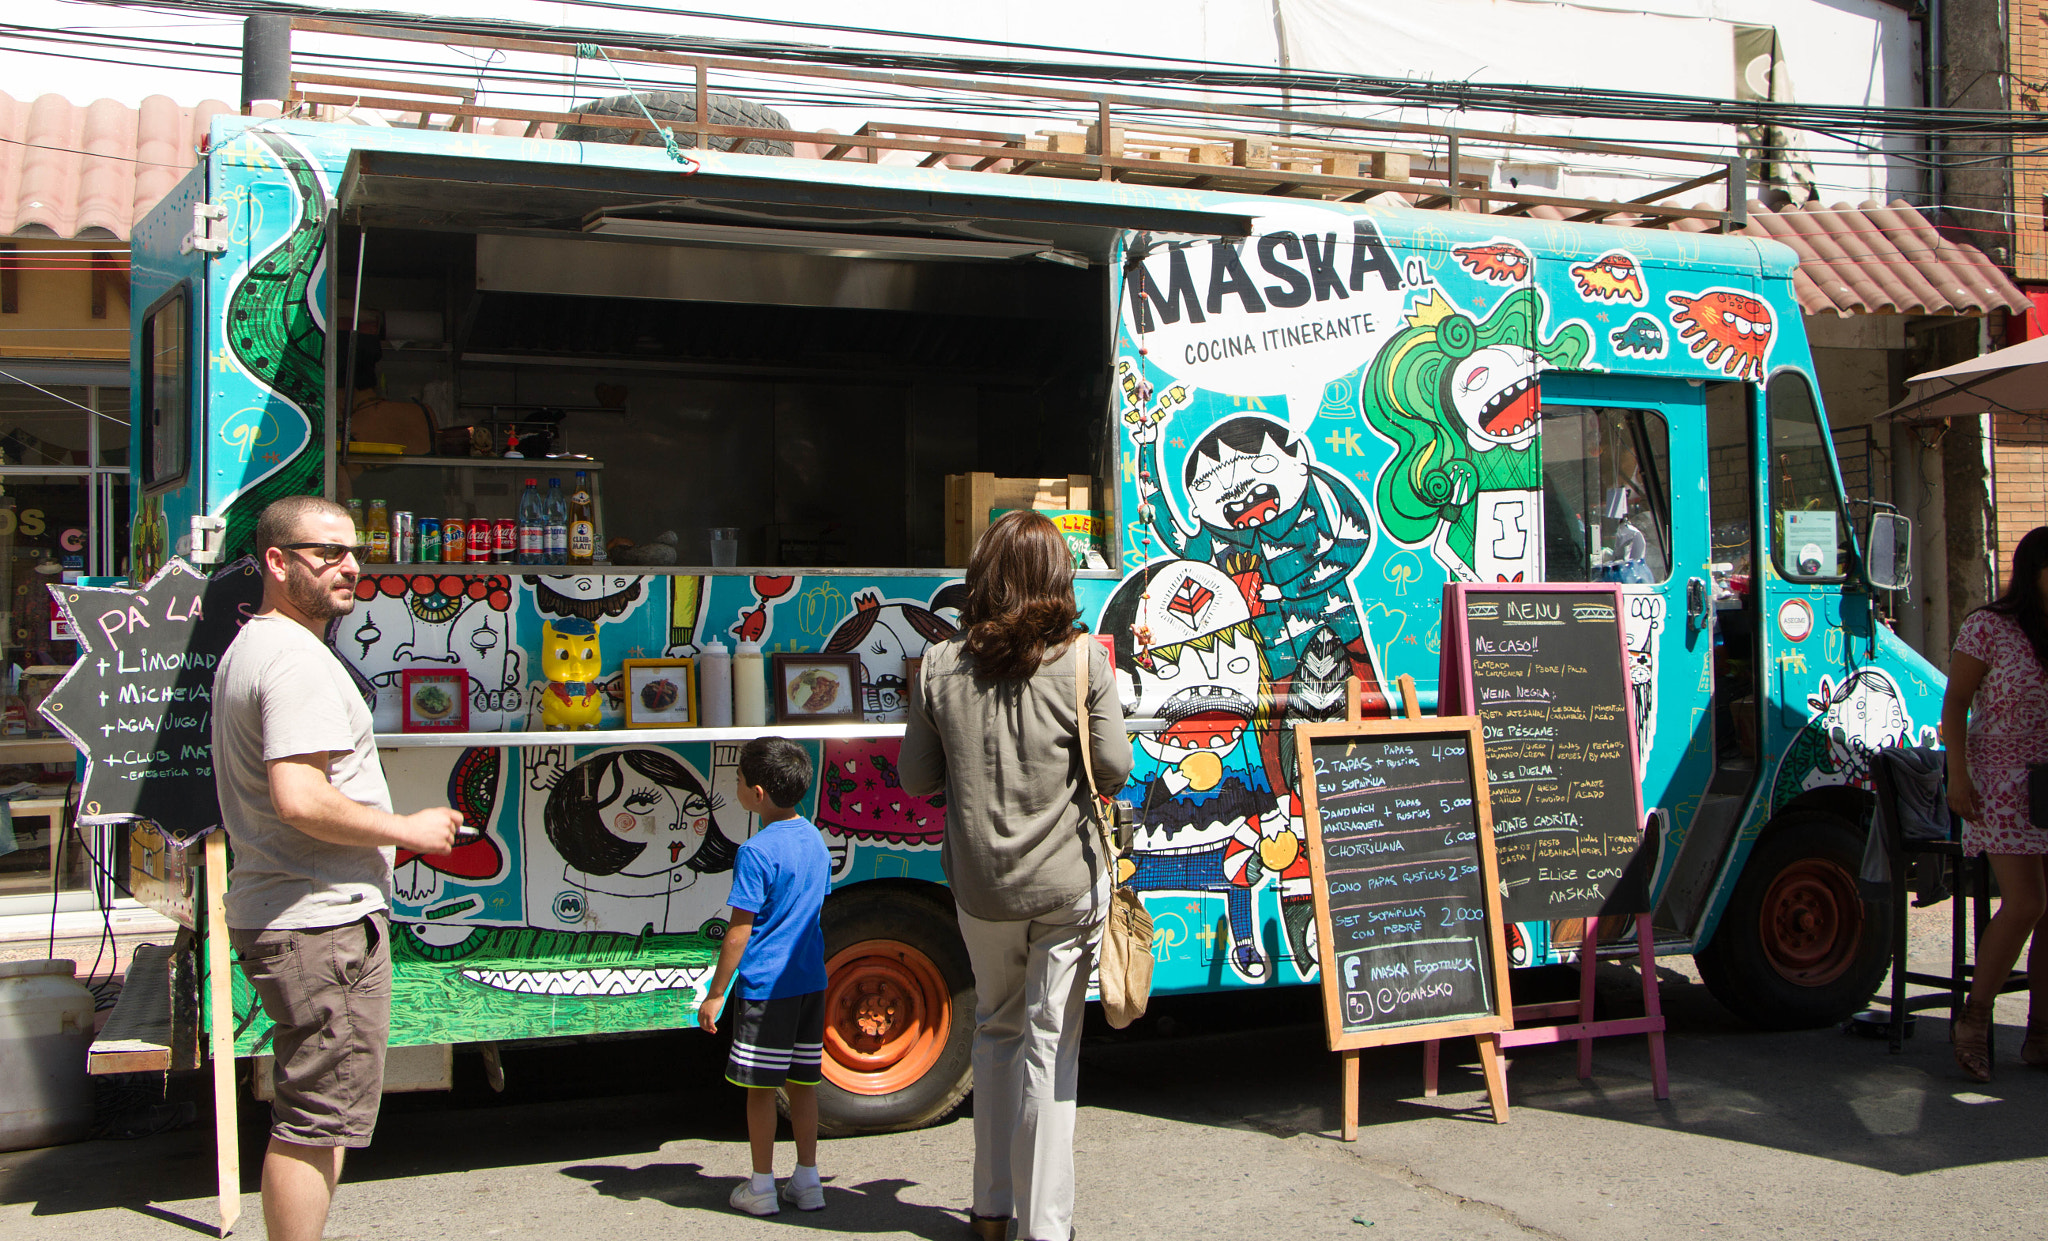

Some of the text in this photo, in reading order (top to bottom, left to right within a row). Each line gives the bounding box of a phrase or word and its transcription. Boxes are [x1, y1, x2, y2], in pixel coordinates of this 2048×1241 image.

[1122, 217, 1402, 335] MASKA
[1185, 313, 1377, 366] COCINA ITINERANTE
[1062, 516, 1105, 537] LLEN
[166, 595, 204, 622] LA
[1507, 601, 1561, 620] MENU
[117, 648, 217, 674] LIMONAD
[1482, 725, 1504, 739] OYE
[1313, 758, 1330, 776] 2
[1331, 756, 1373, 773] TAPAS
[1383, 744, 1414, 756] PAPAS
[1431, 745, 1466, 763] 4.000
[1395, 799, 1422, 809] PAPAS
[1439, 798, 1473, 814] 5.000
[1443, 831, 1478, 846] 6.000
[1586, 868, 1623, 880] COMO
[1329, 880, 1362, 895] CONO
[1368, 875, 1399, 890] PAPAS
[1549, 883, 1606, 905] MASKAR
[1335, 914, 1361, 927] SET
[1440, 907, 1485, 927] 2.000
[1351, 929, 1376, 940] CON
[1370, 962, 1410, 982] MASKA
